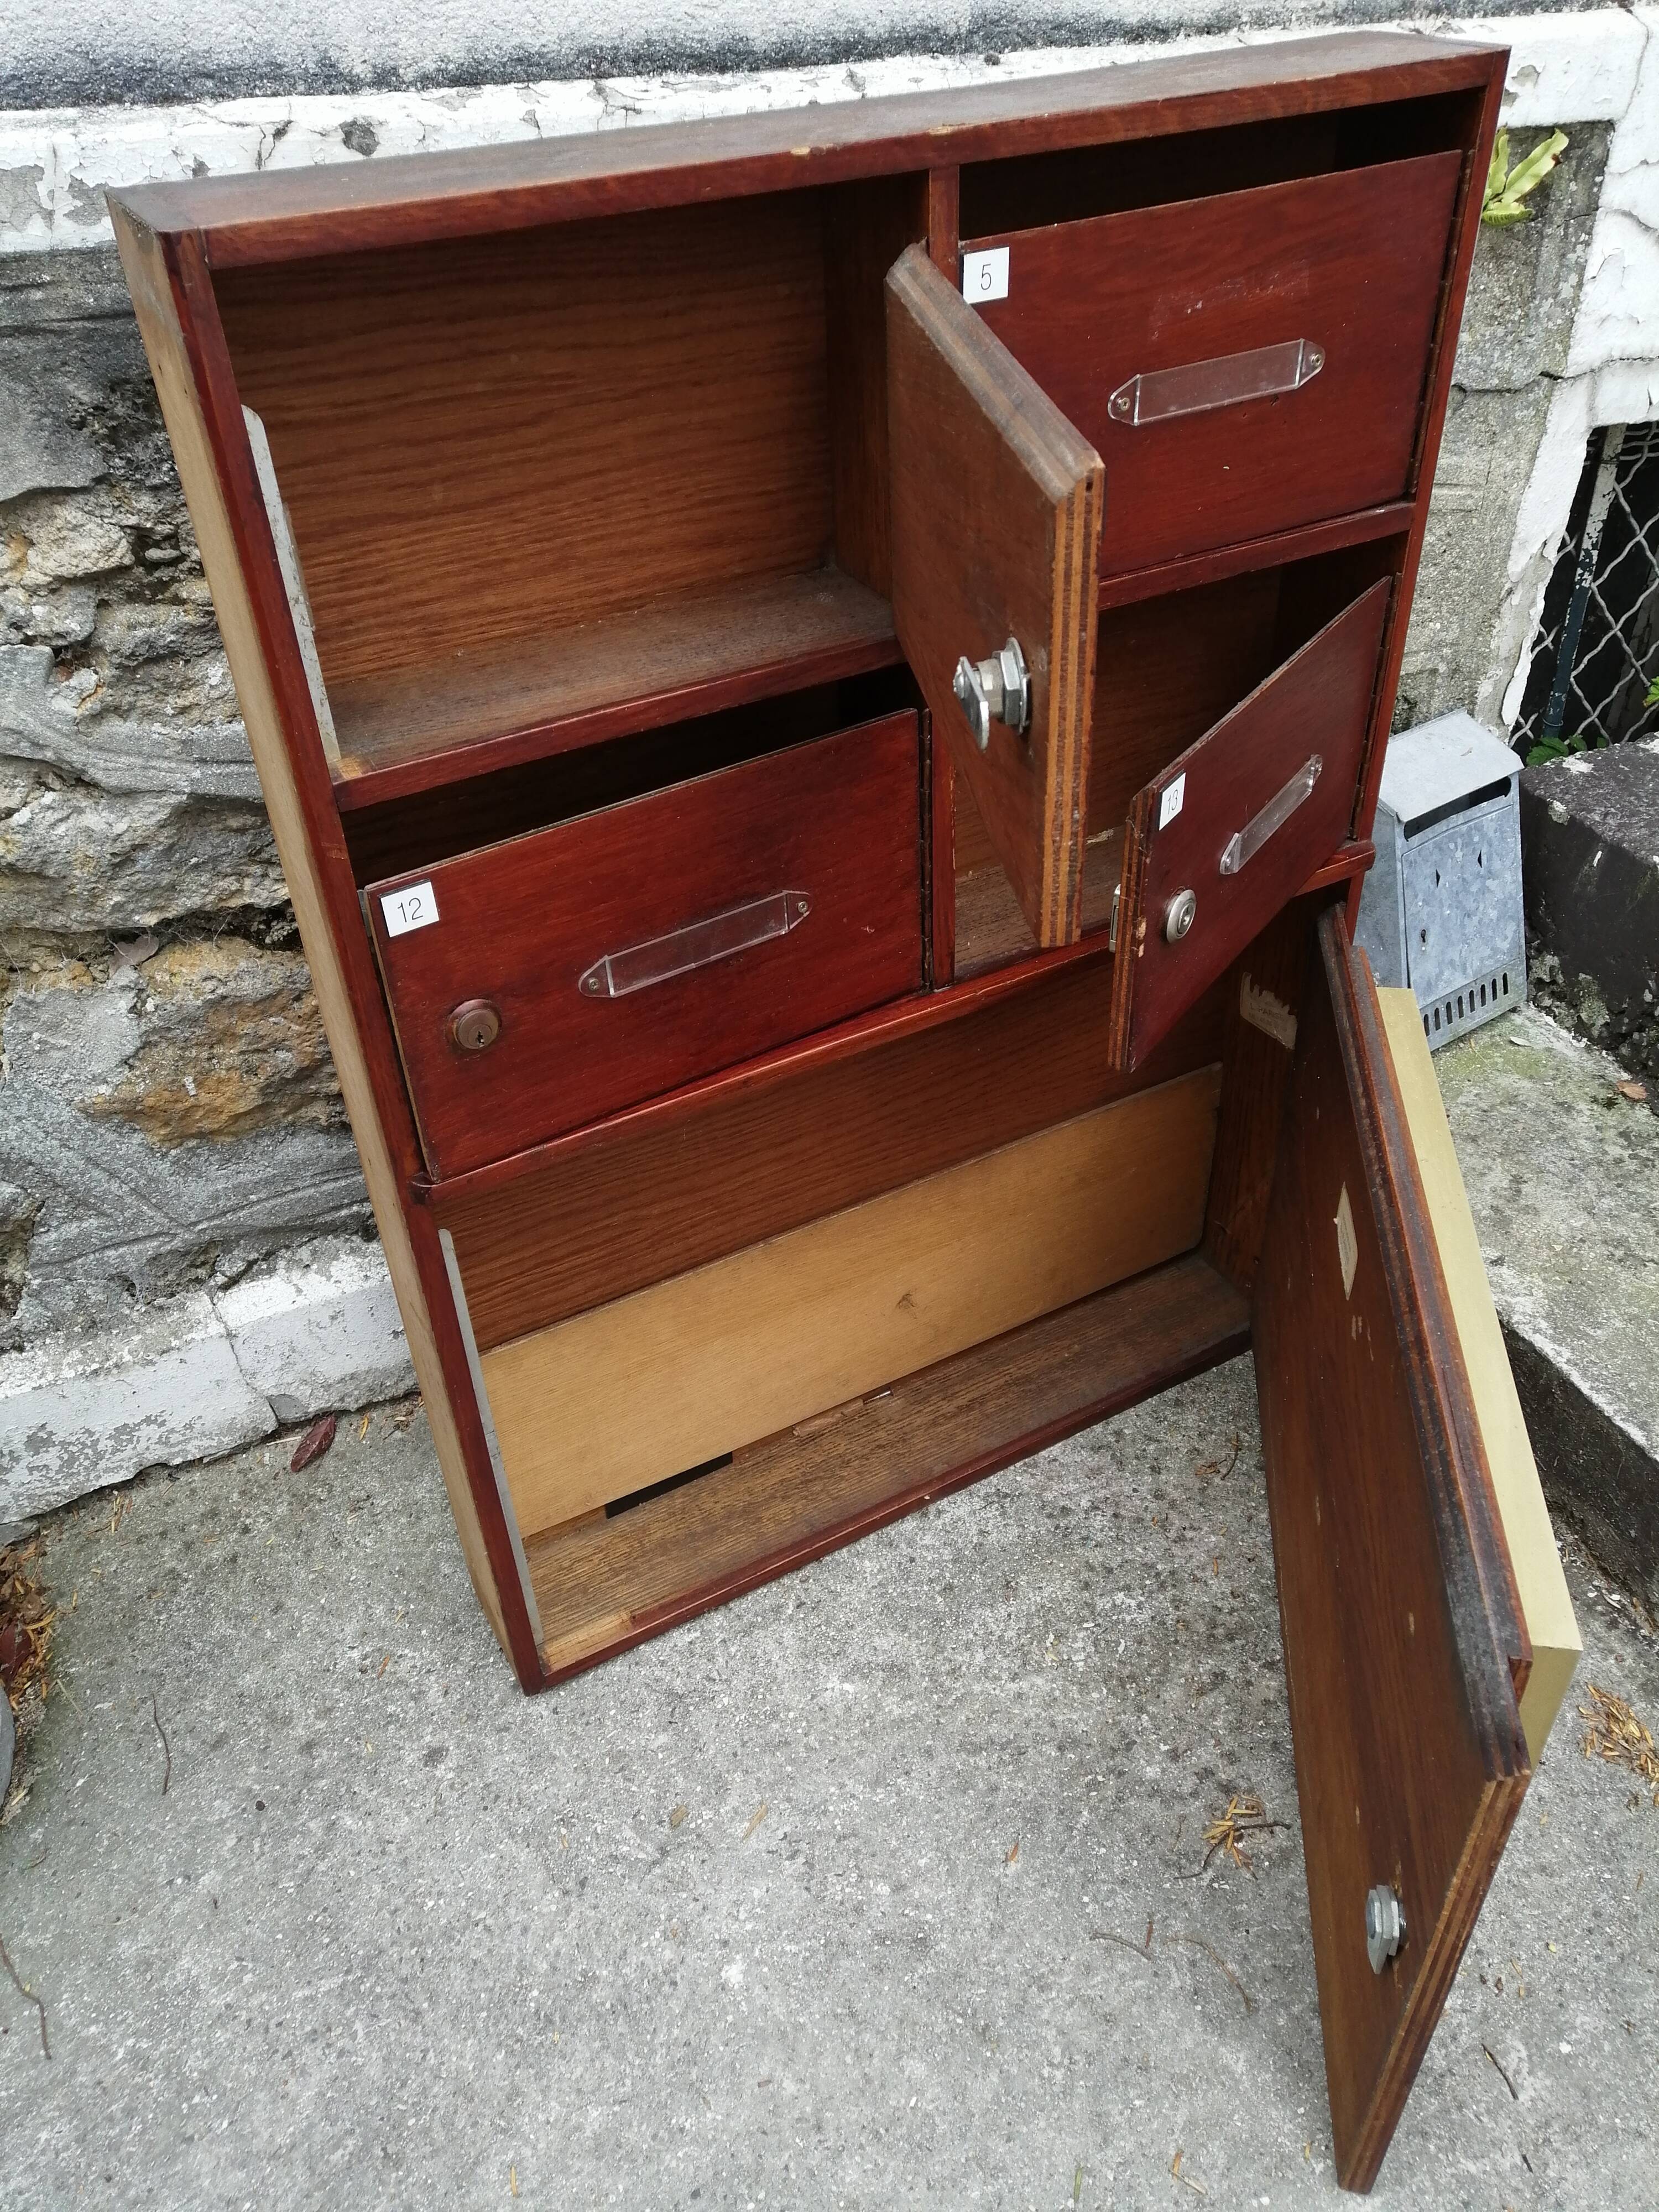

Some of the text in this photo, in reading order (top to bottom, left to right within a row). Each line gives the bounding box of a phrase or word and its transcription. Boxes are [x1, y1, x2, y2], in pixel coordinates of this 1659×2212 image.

[980, 263, 992, 290] 5
[1167, 789, 1178, 815] 13
[397, 898, 424, 922] 12
